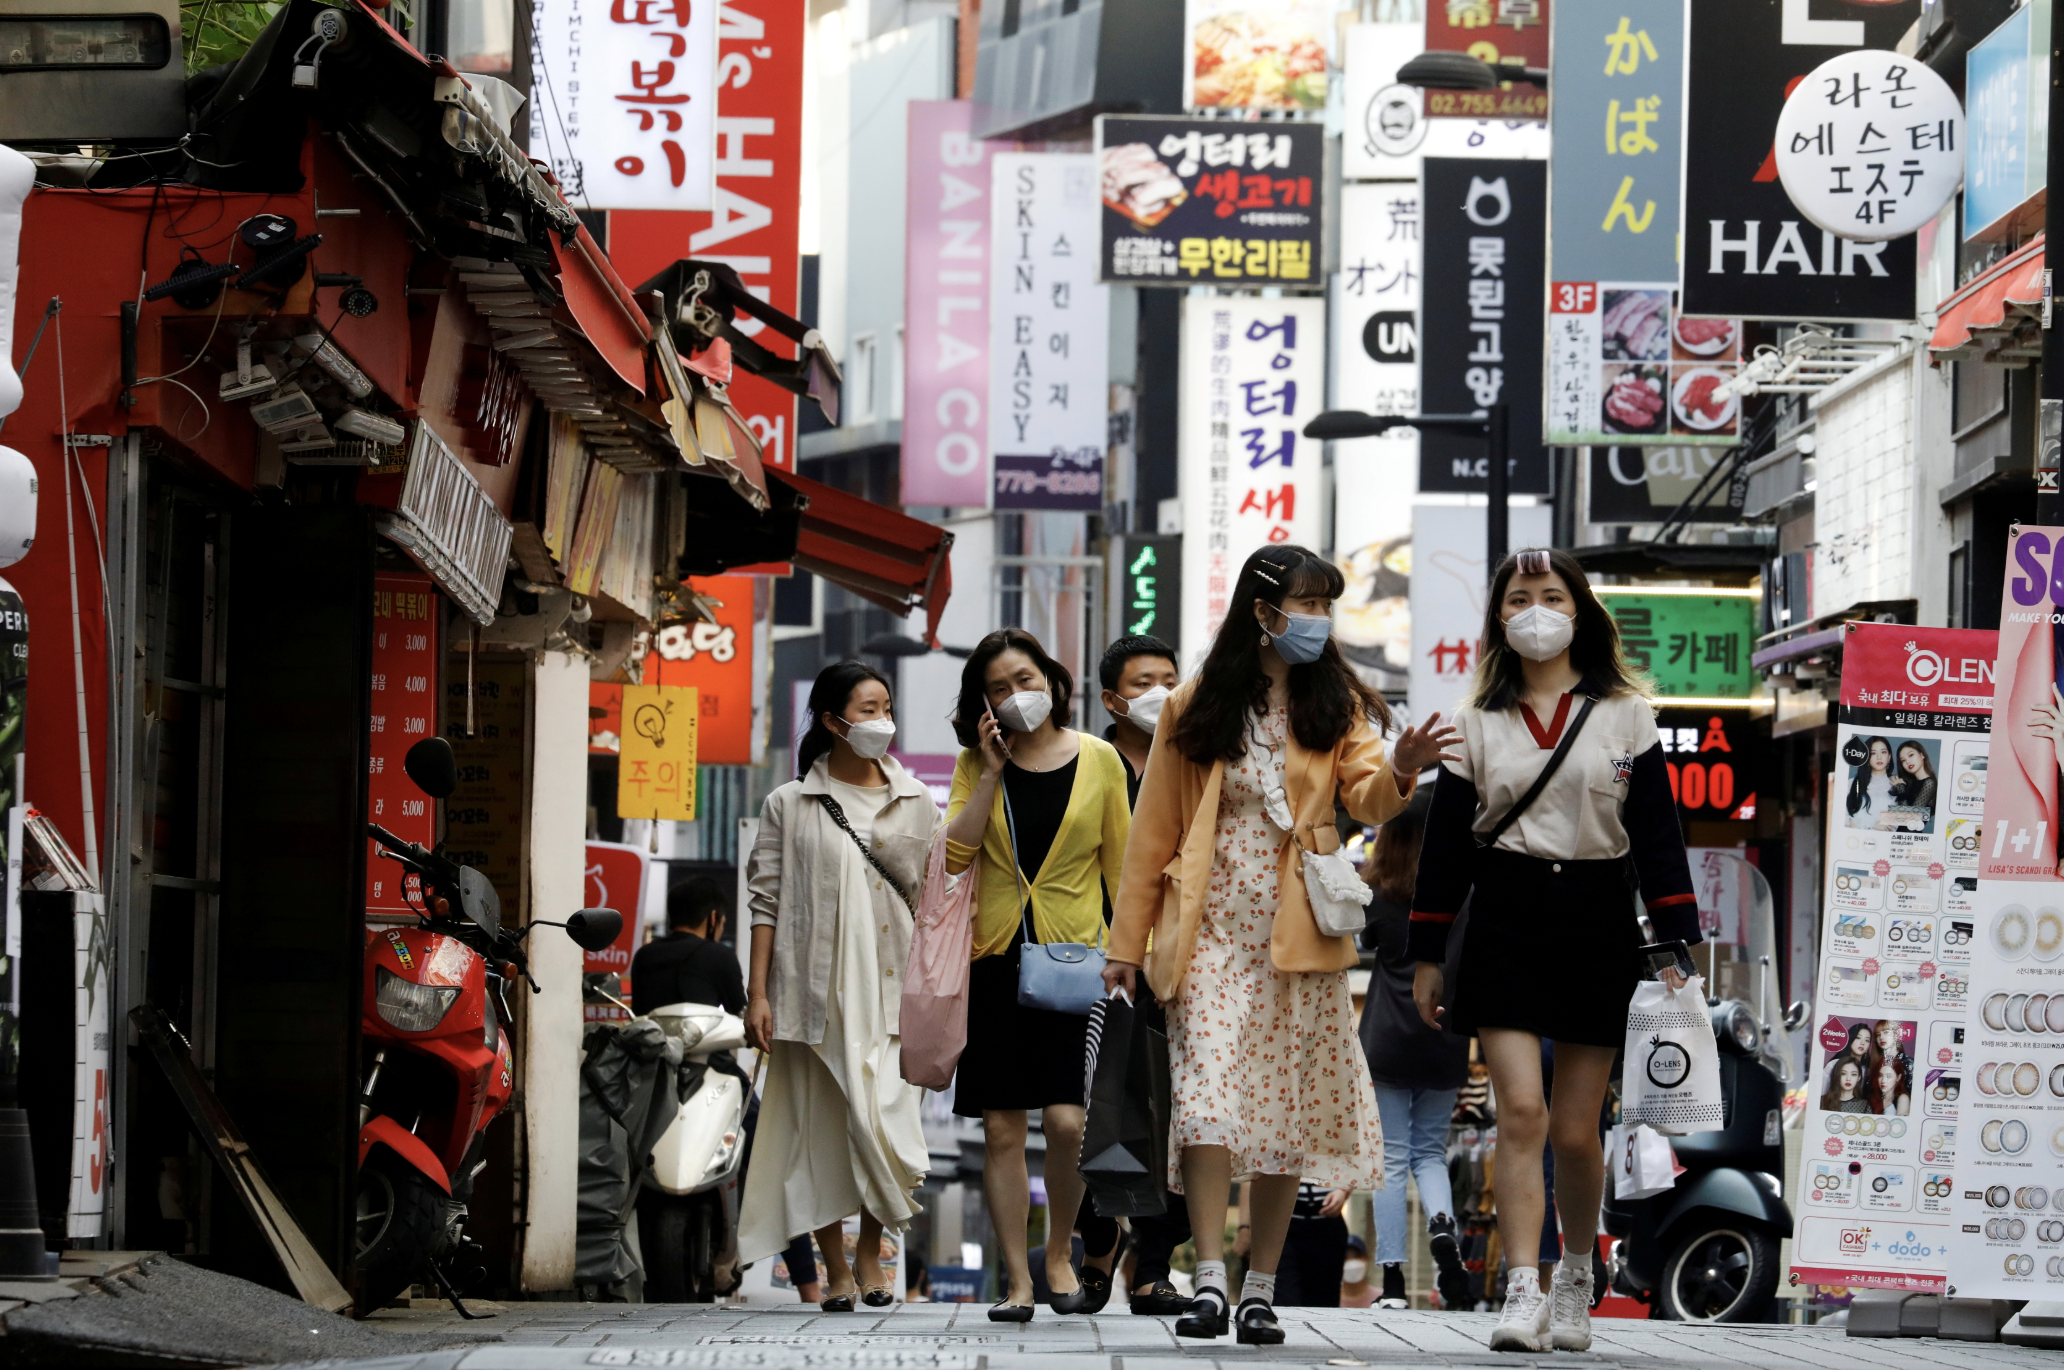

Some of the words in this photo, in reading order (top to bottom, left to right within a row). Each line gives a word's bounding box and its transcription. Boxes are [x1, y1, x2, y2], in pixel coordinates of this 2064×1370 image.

[1823, 65, 1917, 109] 라온
[567, 80, 581, 139] STEW
[1601, 16, 1662, 235] かばん
[1158, 130, 1293, 178] 엉터리
[1790, 119, 1955, 156] 에스테
[1193, 168, 1313, 218] 생고기
[1829, 159, 1924, 197] エステ
[1015, 166, 1036, 293] SKIN
[1855, 199, 1898, 224] 4F
[936, 130, 985, 374] BANILA
[1178, 236, 1312, 279] 무한리필
[1708, 219, 1890, 277] HAIR
[1558, 283, 1594, 312] 3F
[1047, 232, 1073, 410] 스킨이지
[1465, 237, 1506, 417] 못된고양
[1013, 316, 1034, 442] EASY
[1239, 314, 1298, 470] 엉터리
[936, 388, 981, 476] CO
[395, 592, 428, 621] 떡볶이
[2008, 612, 2041, 623] MAKE
[405, 634, 427, 651] 3,000
[1667, 631, 1739, 675] 카페
[405, 675, 427, 693] 4,000
[1858, 691, 1878, 704] 국내
[1880, 689, 1908, 705] 최다
[1908, 694, 1930, 707] 보유
[370, 715, 386, 732] 김밥
[403, 717, 426, 734] 3,000
[1894, 712, 1929, 727] 일회용
[1933, 714, 1979, 728] 칼라렌즈
[1844, 747, 1867, 760] 1-Day
[627, 760, 682, 802] 주의
[402, 800, 424, 817] 5,000
[1991, 820, 2048, 860] 1+1
[1988, 865, 2014, 874] LISA'S
[2015, 865, 2041, 875] SCANDI
[1822, 1028, 1846, 1038] 2Weeks
[1653, 1060, 1681, 1068] O-LENS
[1843, 1232, 1864, 1244] OK
[1888, 1241, 1931, 1257] dodo
[1920, 1279, 1935, 1287] 전문
